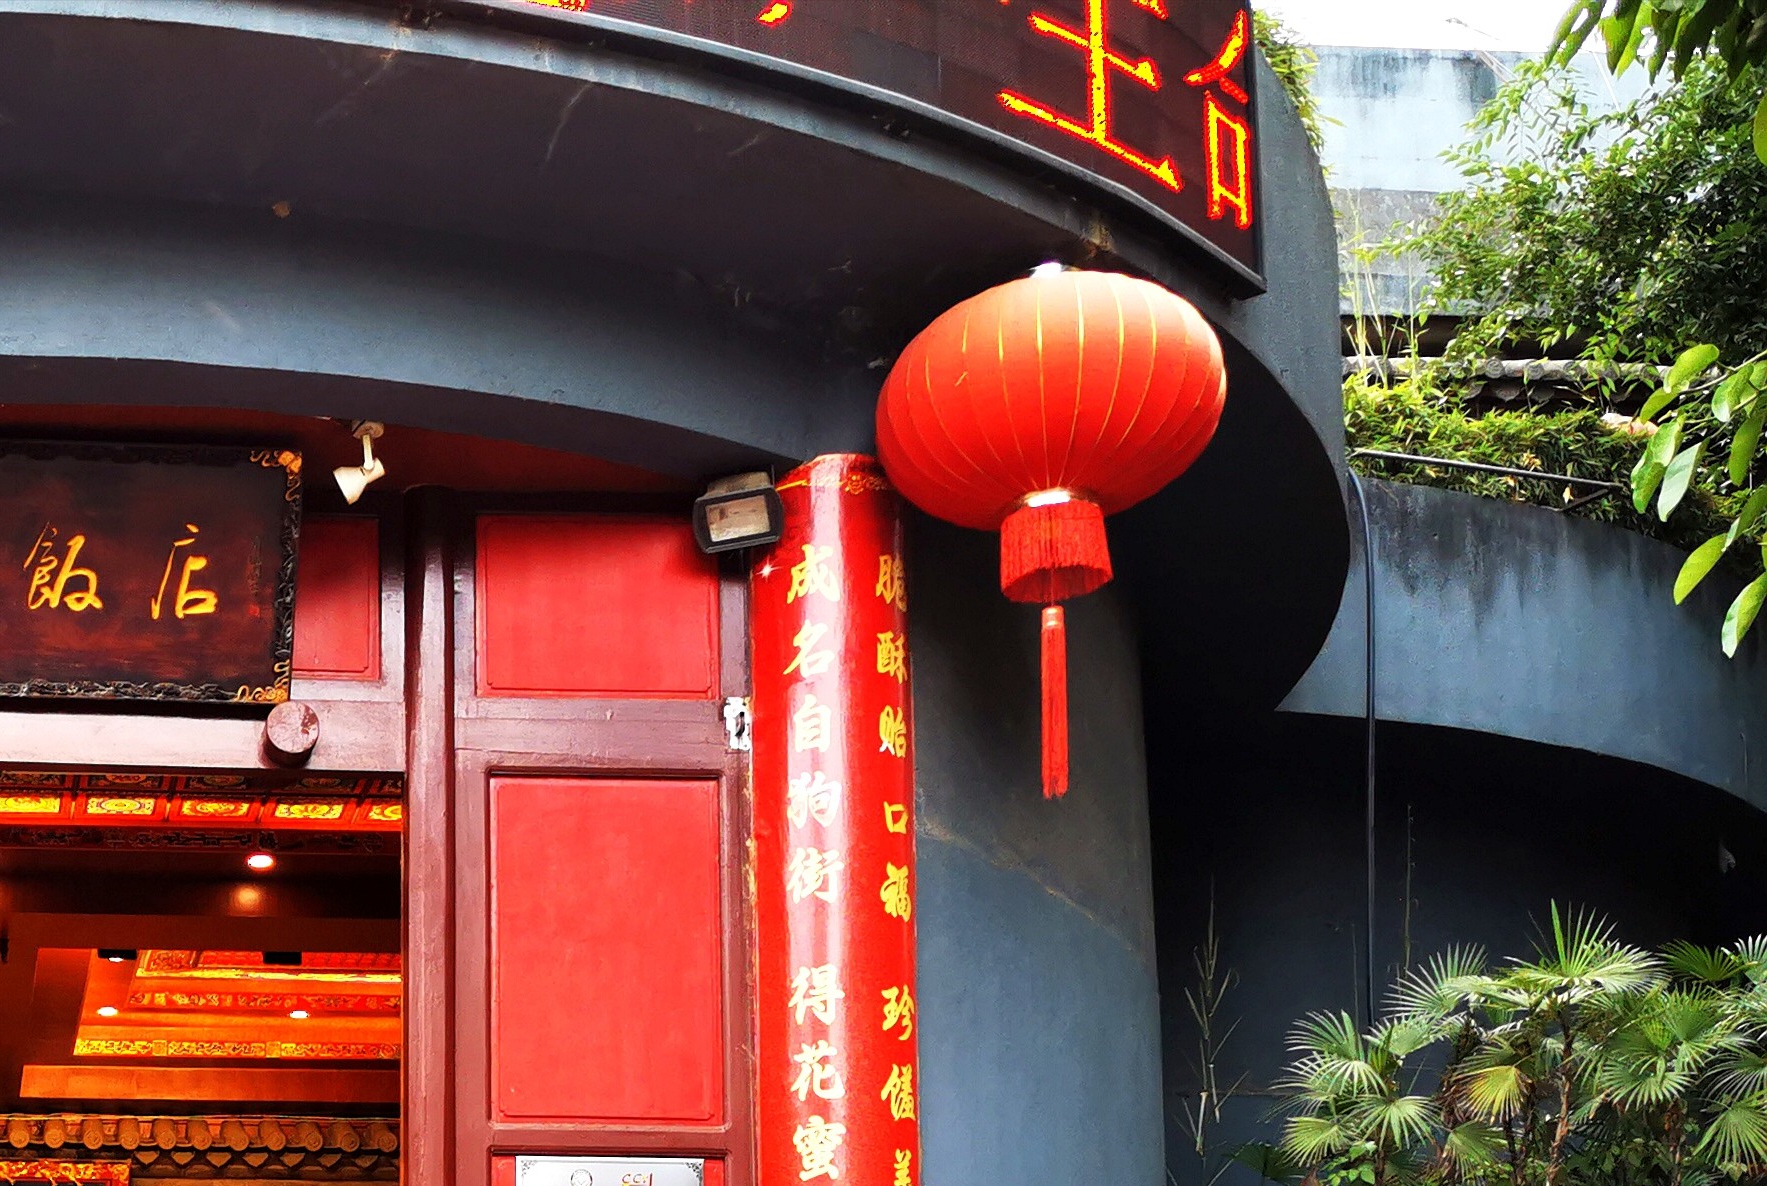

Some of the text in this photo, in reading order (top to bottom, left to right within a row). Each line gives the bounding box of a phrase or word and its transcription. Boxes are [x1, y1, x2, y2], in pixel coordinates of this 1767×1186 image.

[783, 543, 845, 905] 成名自狗街
